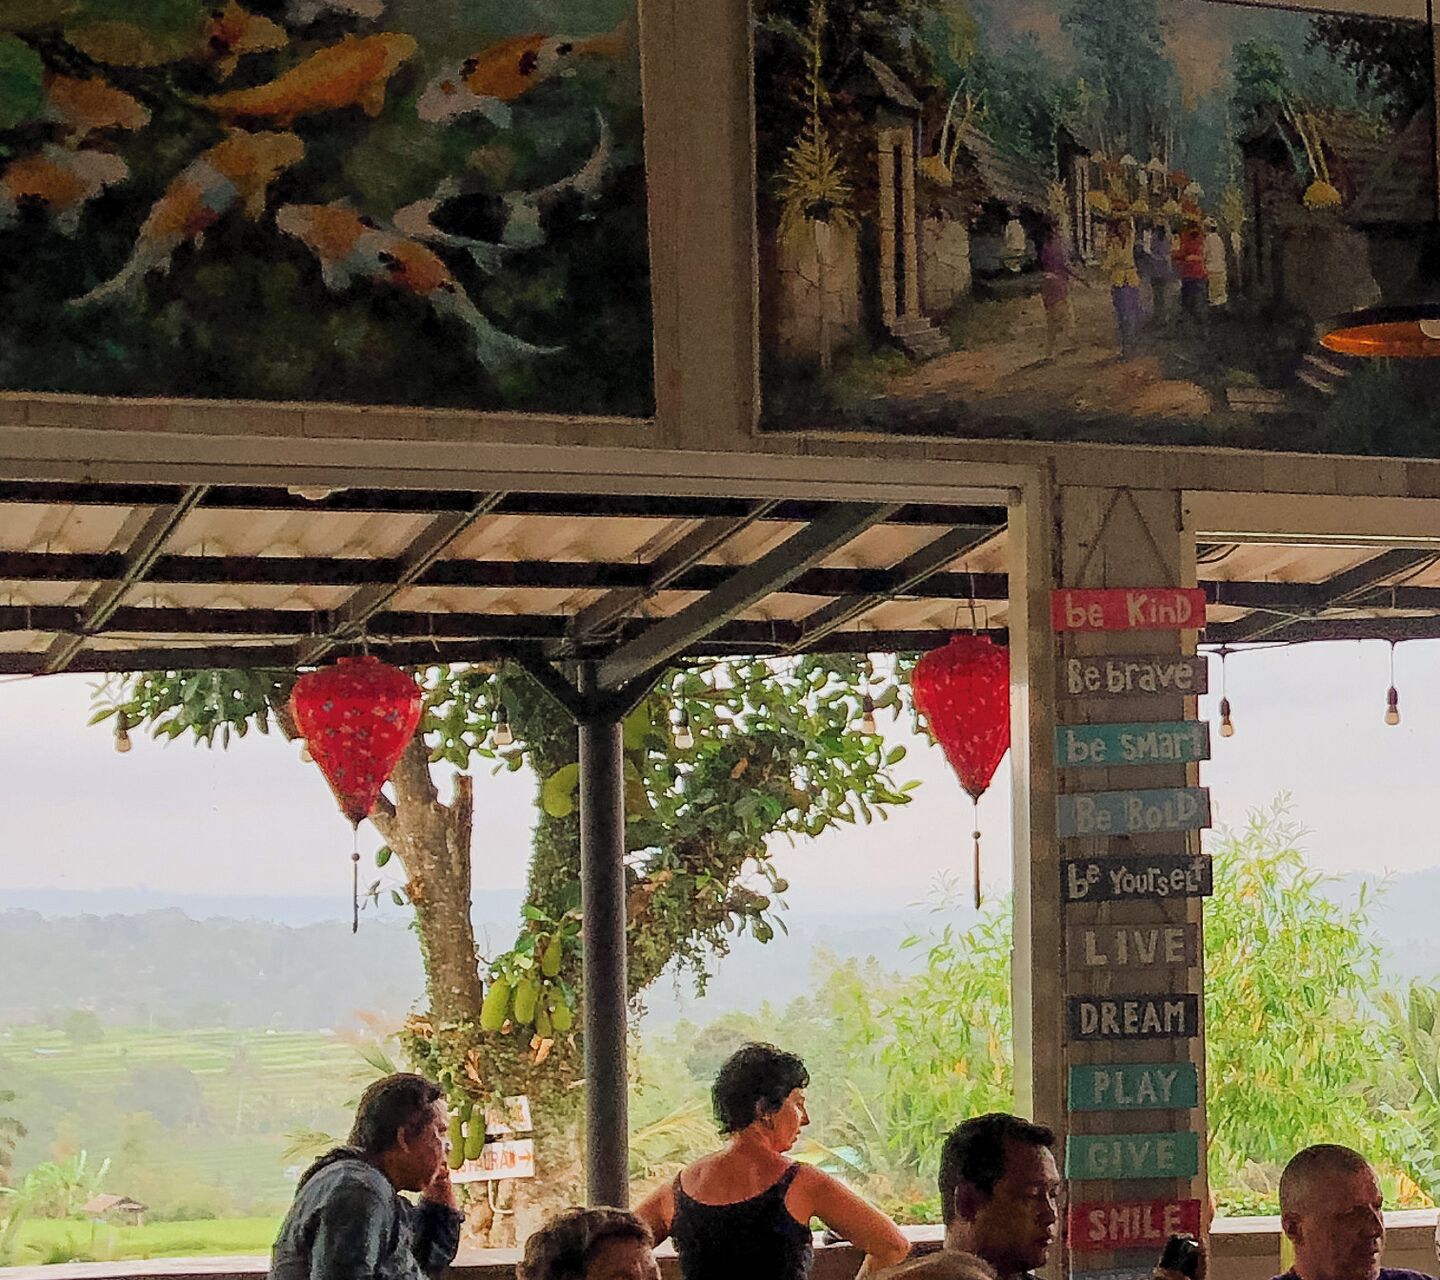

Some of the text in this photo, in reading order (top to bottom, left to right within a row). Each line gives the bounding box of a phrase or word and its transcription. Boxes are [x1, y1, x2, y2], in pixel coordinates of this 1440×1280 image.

[1065, 592, 1104, 628] be
[1106, 659, 1194, 693] brave
[1066, 729, 1105, 763] be
[1076, 796, 1112, 833] Be
[1067, 863, 1100, 899] be
[1085, 928, 1185, 966] LIVE
[1080, 1001, 1186, 1034] DREAM
[1093, 1070, 1178, 1105] PLAY
[1087, 1139, 1176, 1173] GIVE
[1088, 1203, 1182, 1241] SMILE
